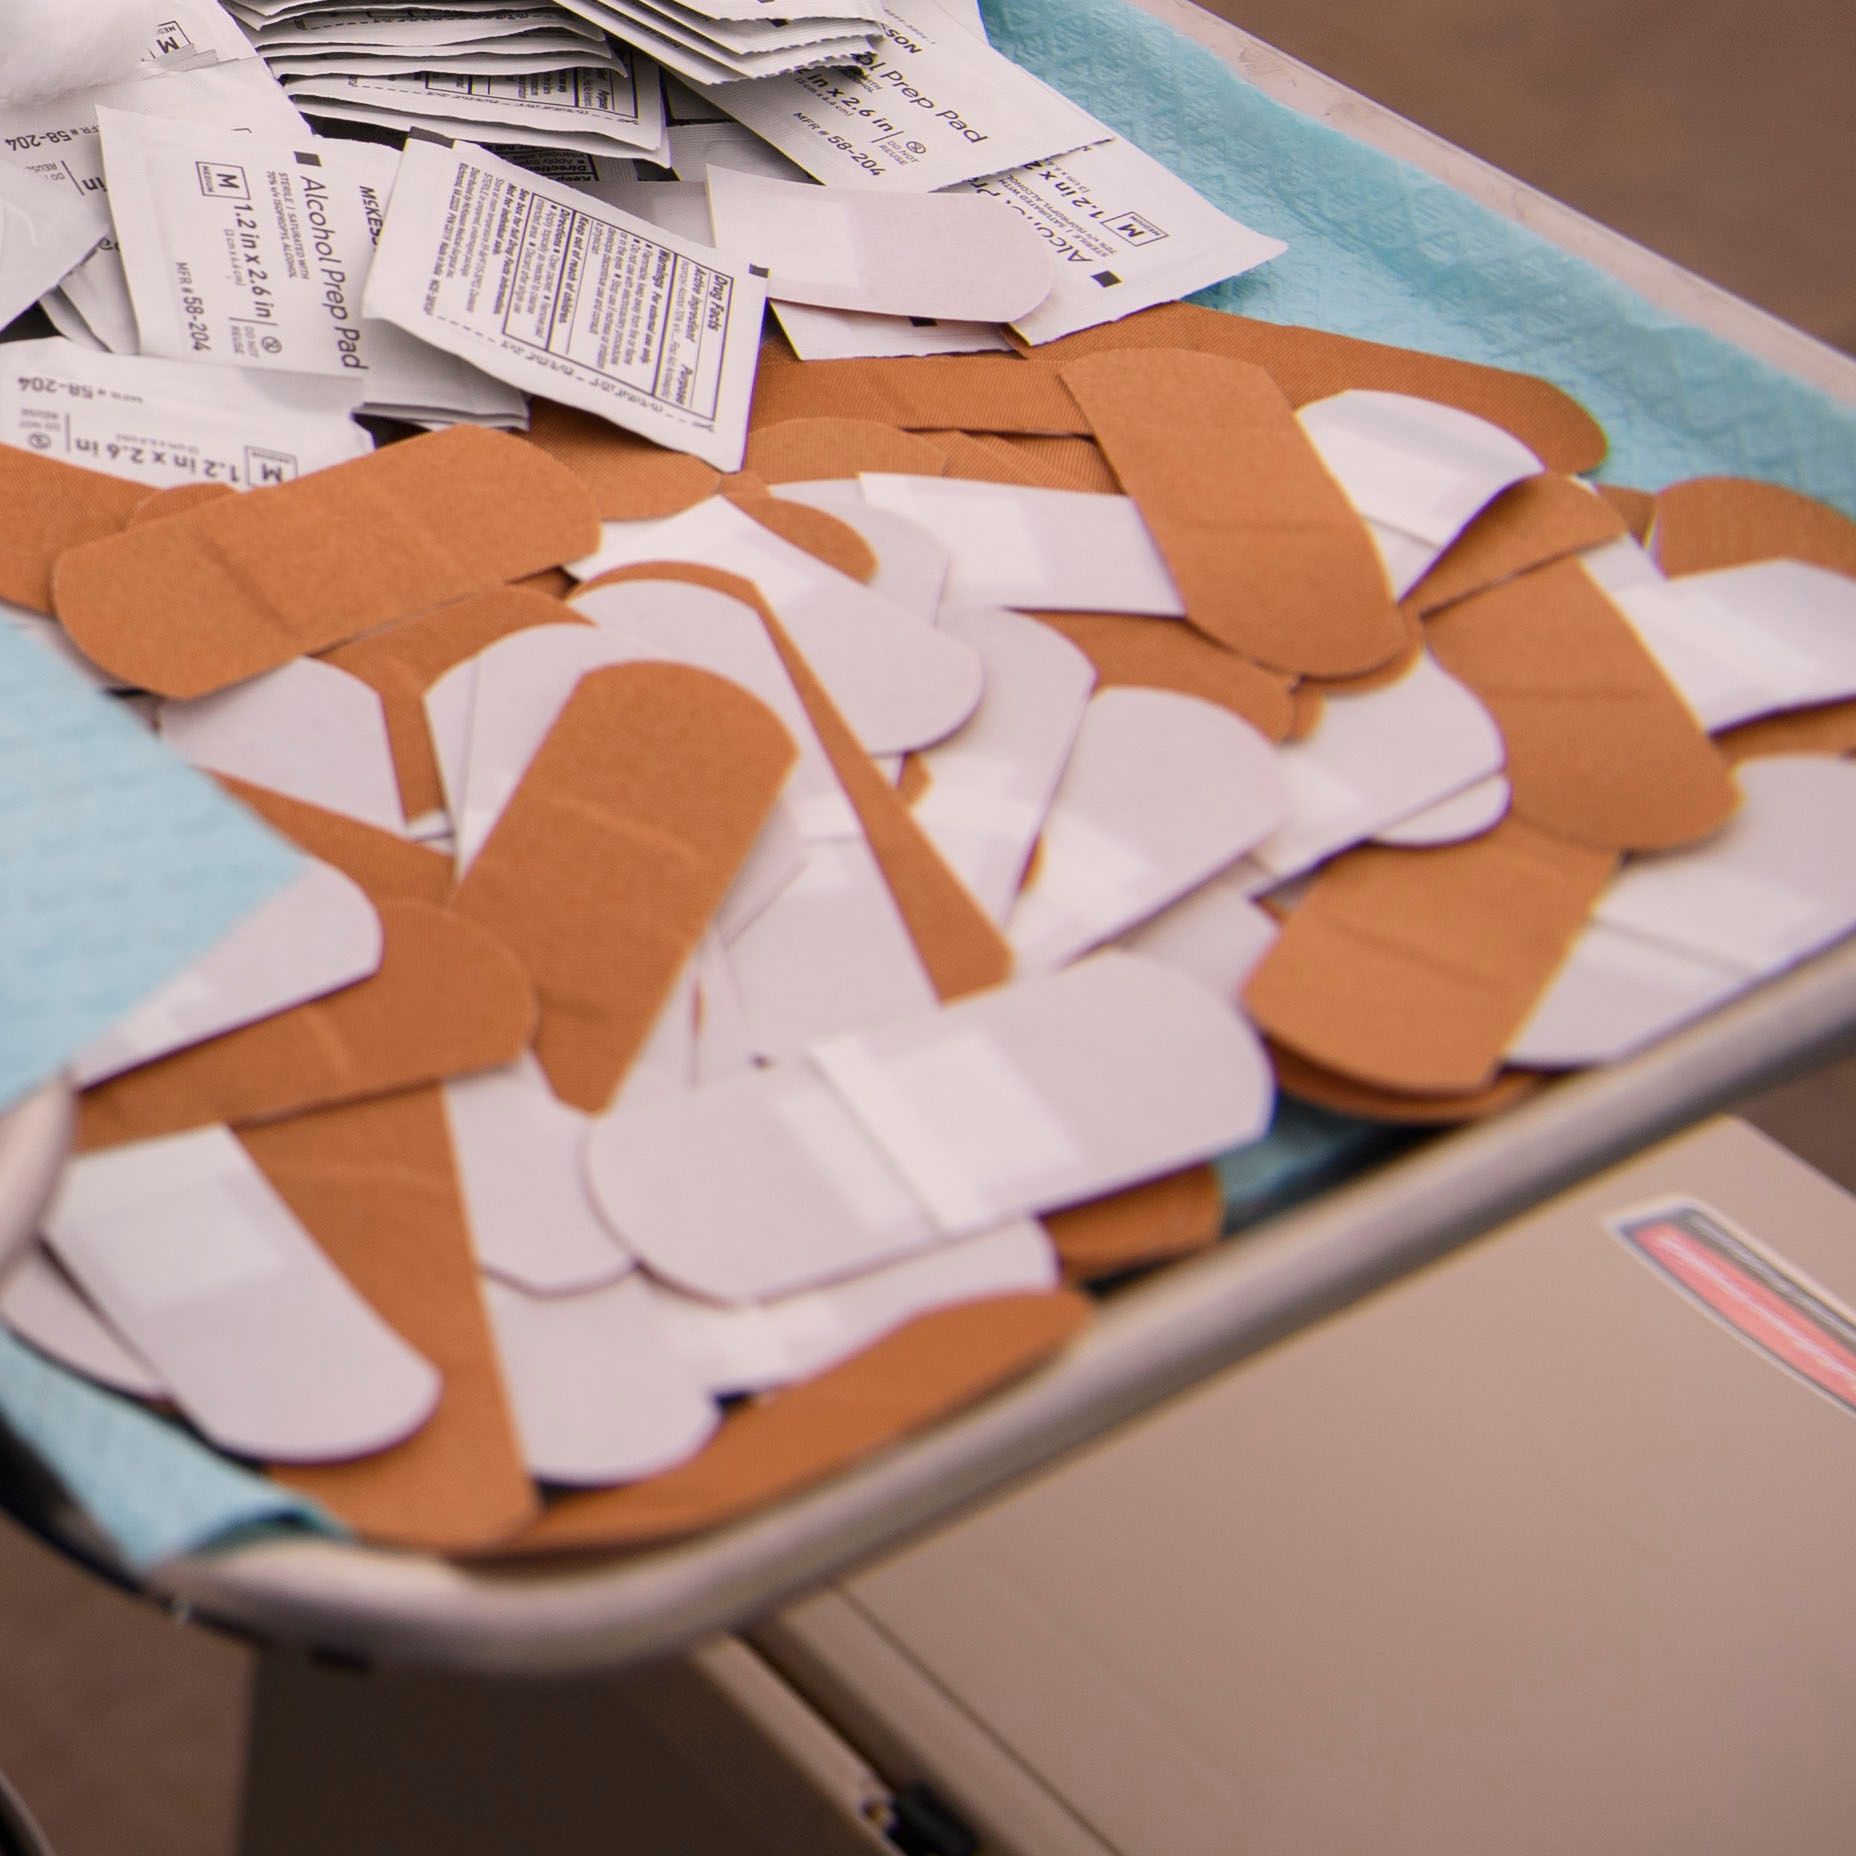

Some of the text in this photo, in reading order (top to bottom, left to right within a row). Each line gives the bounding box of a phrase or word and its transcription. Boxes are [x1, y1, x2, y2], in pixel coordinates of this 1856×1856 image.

[155, 36, 181, 54] M
[807, 75, 894, 132] in x 2.6 in
[880, 70, 935, 109] Prep
[793, 112, 821, 130] MFR
[827, 135, 886, 176] 58-204
[935, 109, 989, 144] Pad
[877, 144, 909, 167] REUSE
[884, 140, 921, 163] DO NOT
[199, 163, 215, 195] MEDIUM
[216, 173, 240, 189] M
[1038, 170, 1058, 181] x
[1054, 181, 1077, 198] in
[265, 170, 298, 279] 70% v/v ISOPROPYL ALCOHOL
[997, 178, 1109, 258] STERILE SATURATED WITH
[1002, 173, 1118, 255] 70% v/v ISOPROPYL ALCOHOL
[1071, 196, 1105, 219] 1.2
[277, 171, 310, 280] STERILE SATURATED WITH
[553, 207, 571, 248] Directions
[1116, 223, 1145, 238] M
[1128, 213, 1165, 240] MEDIUM
[175, 262, 193, 285] MFR
[233, 203, 275, 318] 1.2 in x 2.6 in
[299, 175, 369, 370] Alcohol Prep Pad
[651, 248, 671, 290] Warnings
[707, 270, 730, 332] Drug Facts
[182, 296, 212, 352] 58-204
[231, 325, 246, 355] REUSE
[243, 325, 260, 359] DO NOT
[17, 376, 103, 400] 58-204
[675, 363, 694, 406] Purpose
[75, 438, 241, 484] 1.2 in x 2.6 in
[261, 463, 285, 486] M
